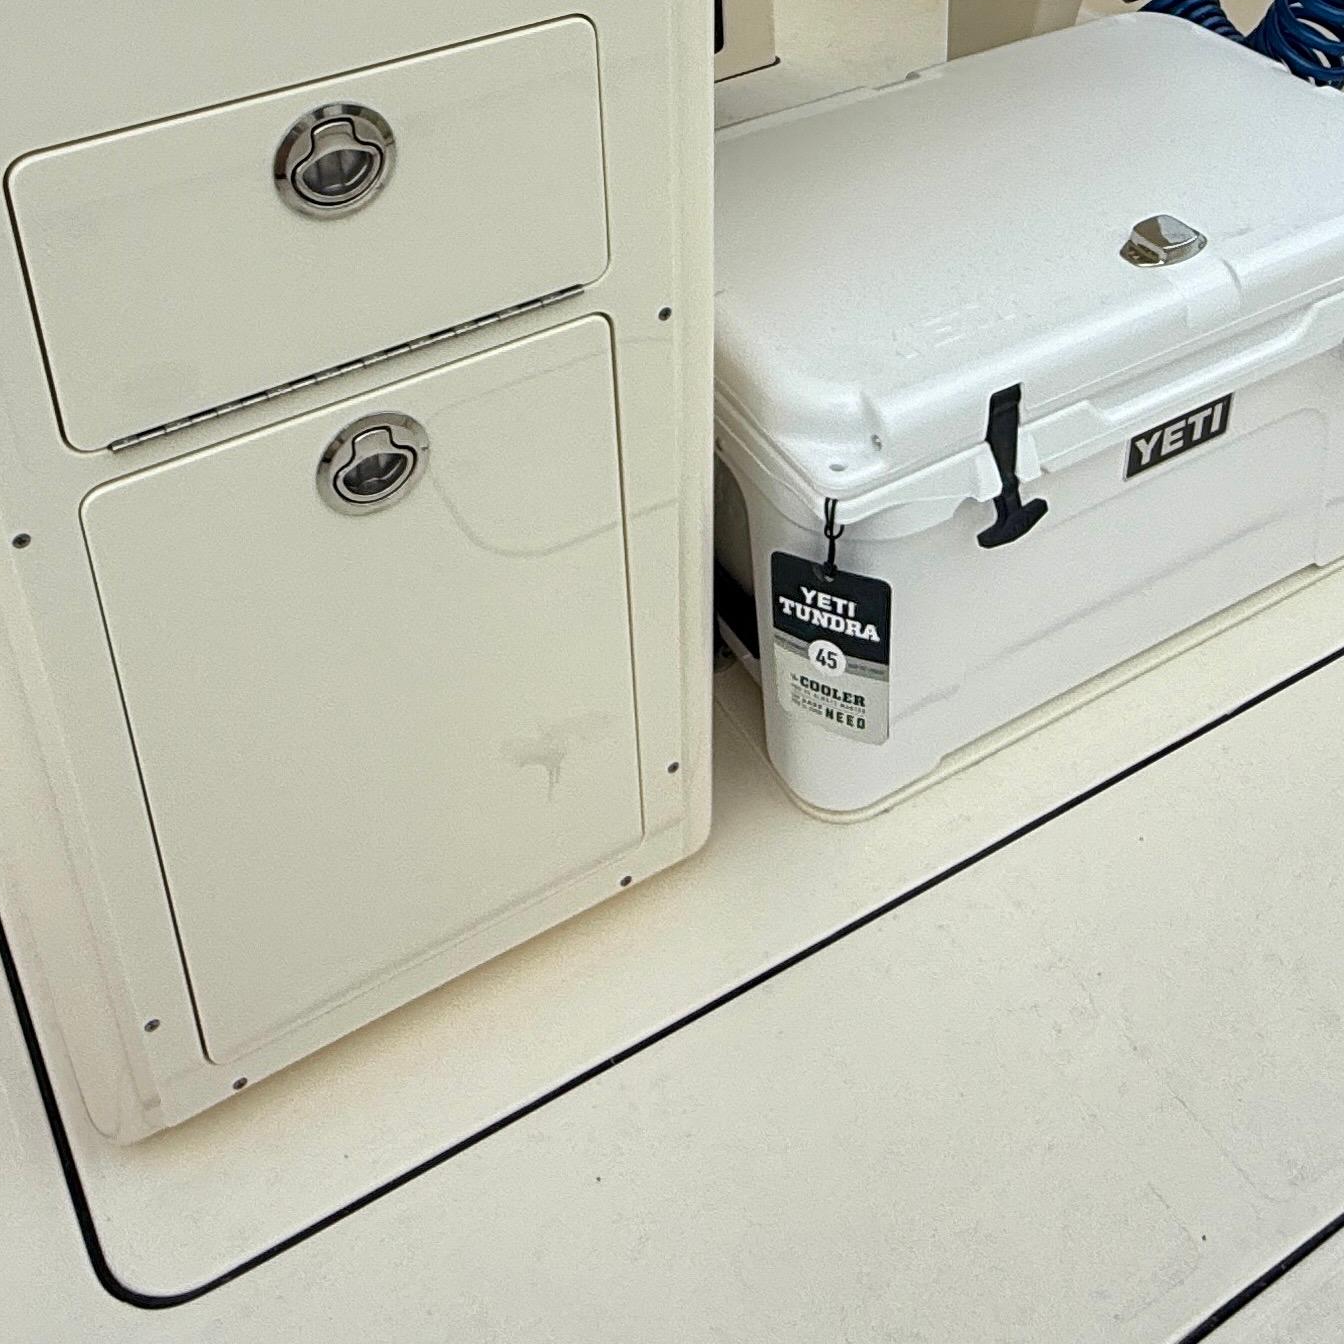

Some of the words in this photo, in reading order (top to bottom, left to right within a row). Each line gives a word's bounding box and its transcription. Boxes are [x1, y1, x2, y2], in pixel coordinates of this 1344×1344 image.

[1135, 402, 1224, 466] YETI
[800, 586, 858, 617] YETI
[779, 596, 881, 642] TUNDRA
[815, 647, 838, 670] 45
[799, 675, 866, 708] COOLER
[825, 707, 866, 730] NEED
